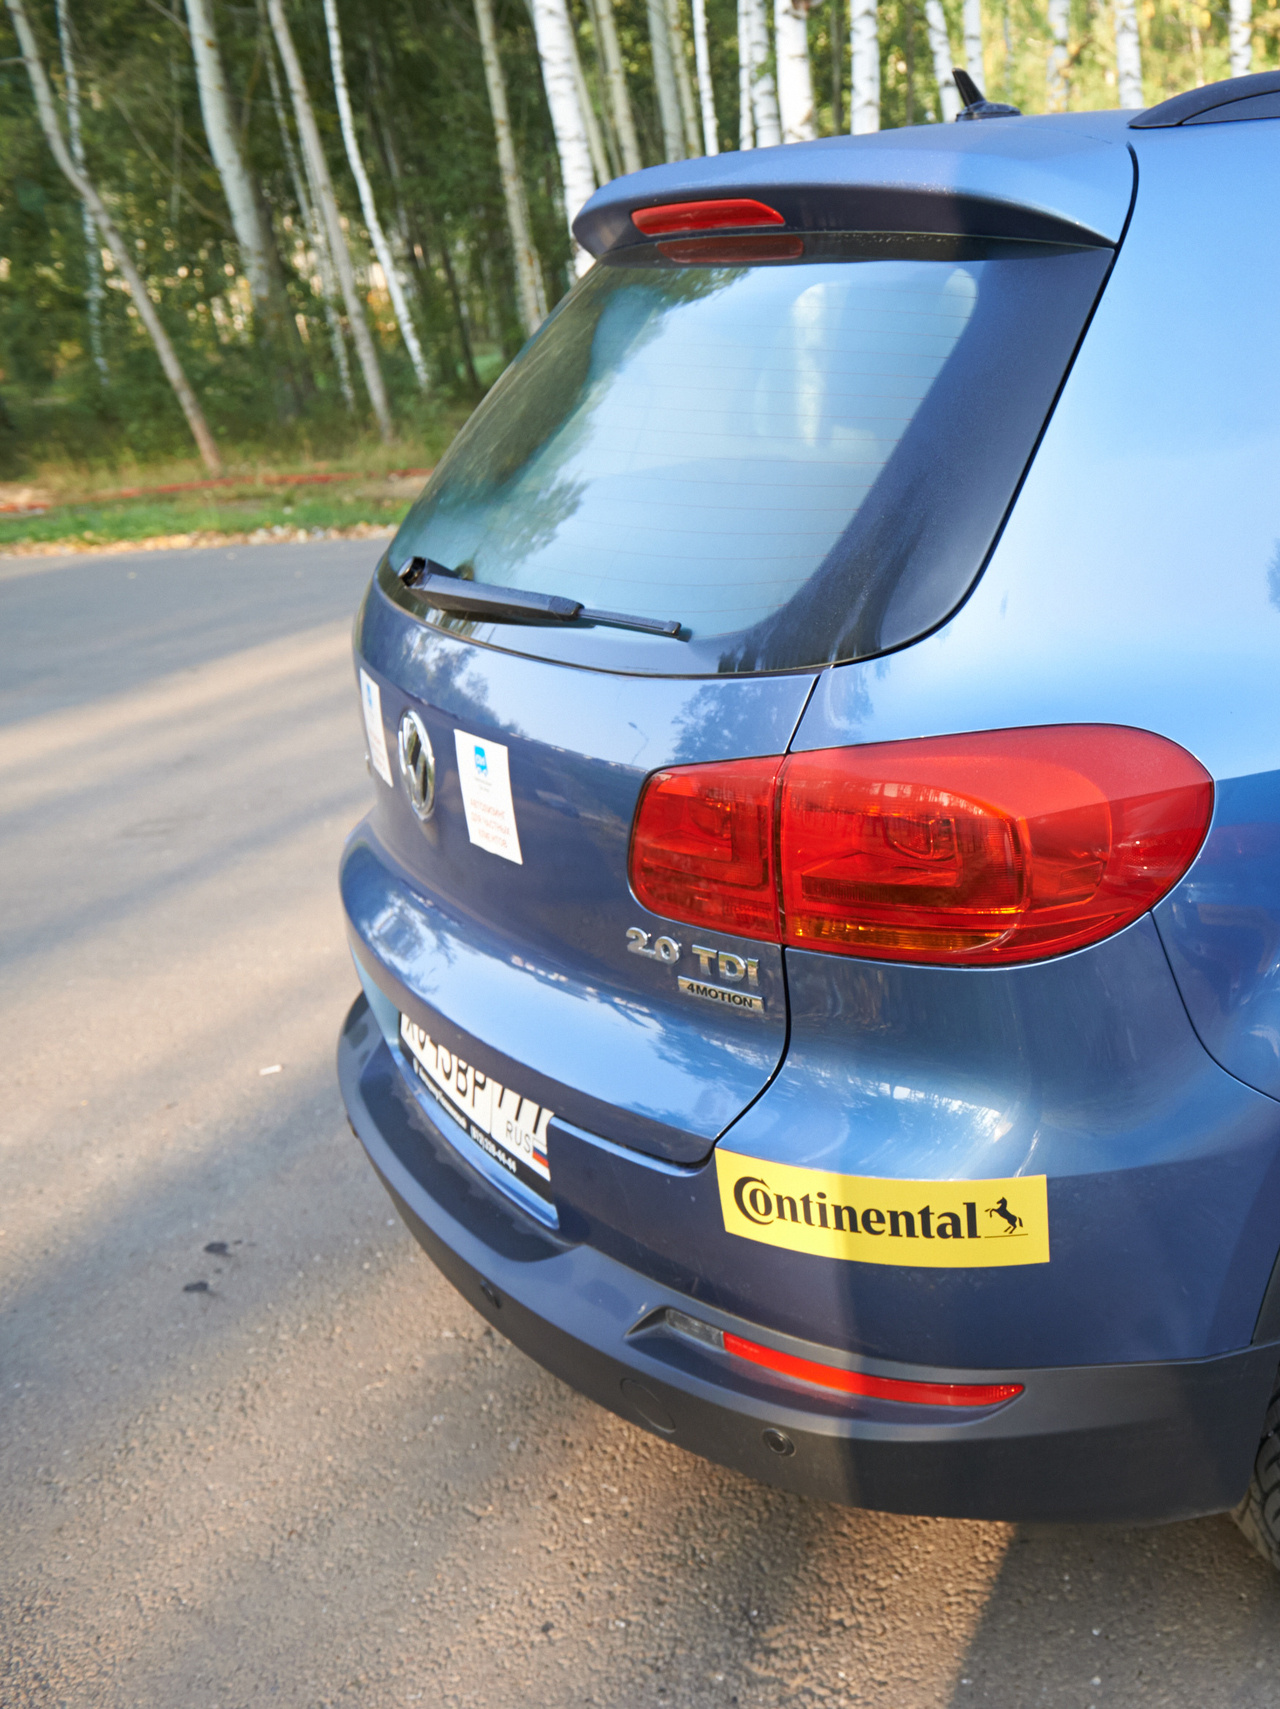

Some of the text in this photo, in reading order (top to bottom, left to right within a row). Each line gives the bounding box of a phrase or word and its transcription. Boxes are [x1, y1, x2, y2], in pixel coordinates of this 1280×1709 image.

[692, 944, 760, 987] TDI
[686, 982, 753, 1009] 4MOTION
[506, 1120, 531, 1154] RUS
[733, 1175, 982, 1240] Continental
